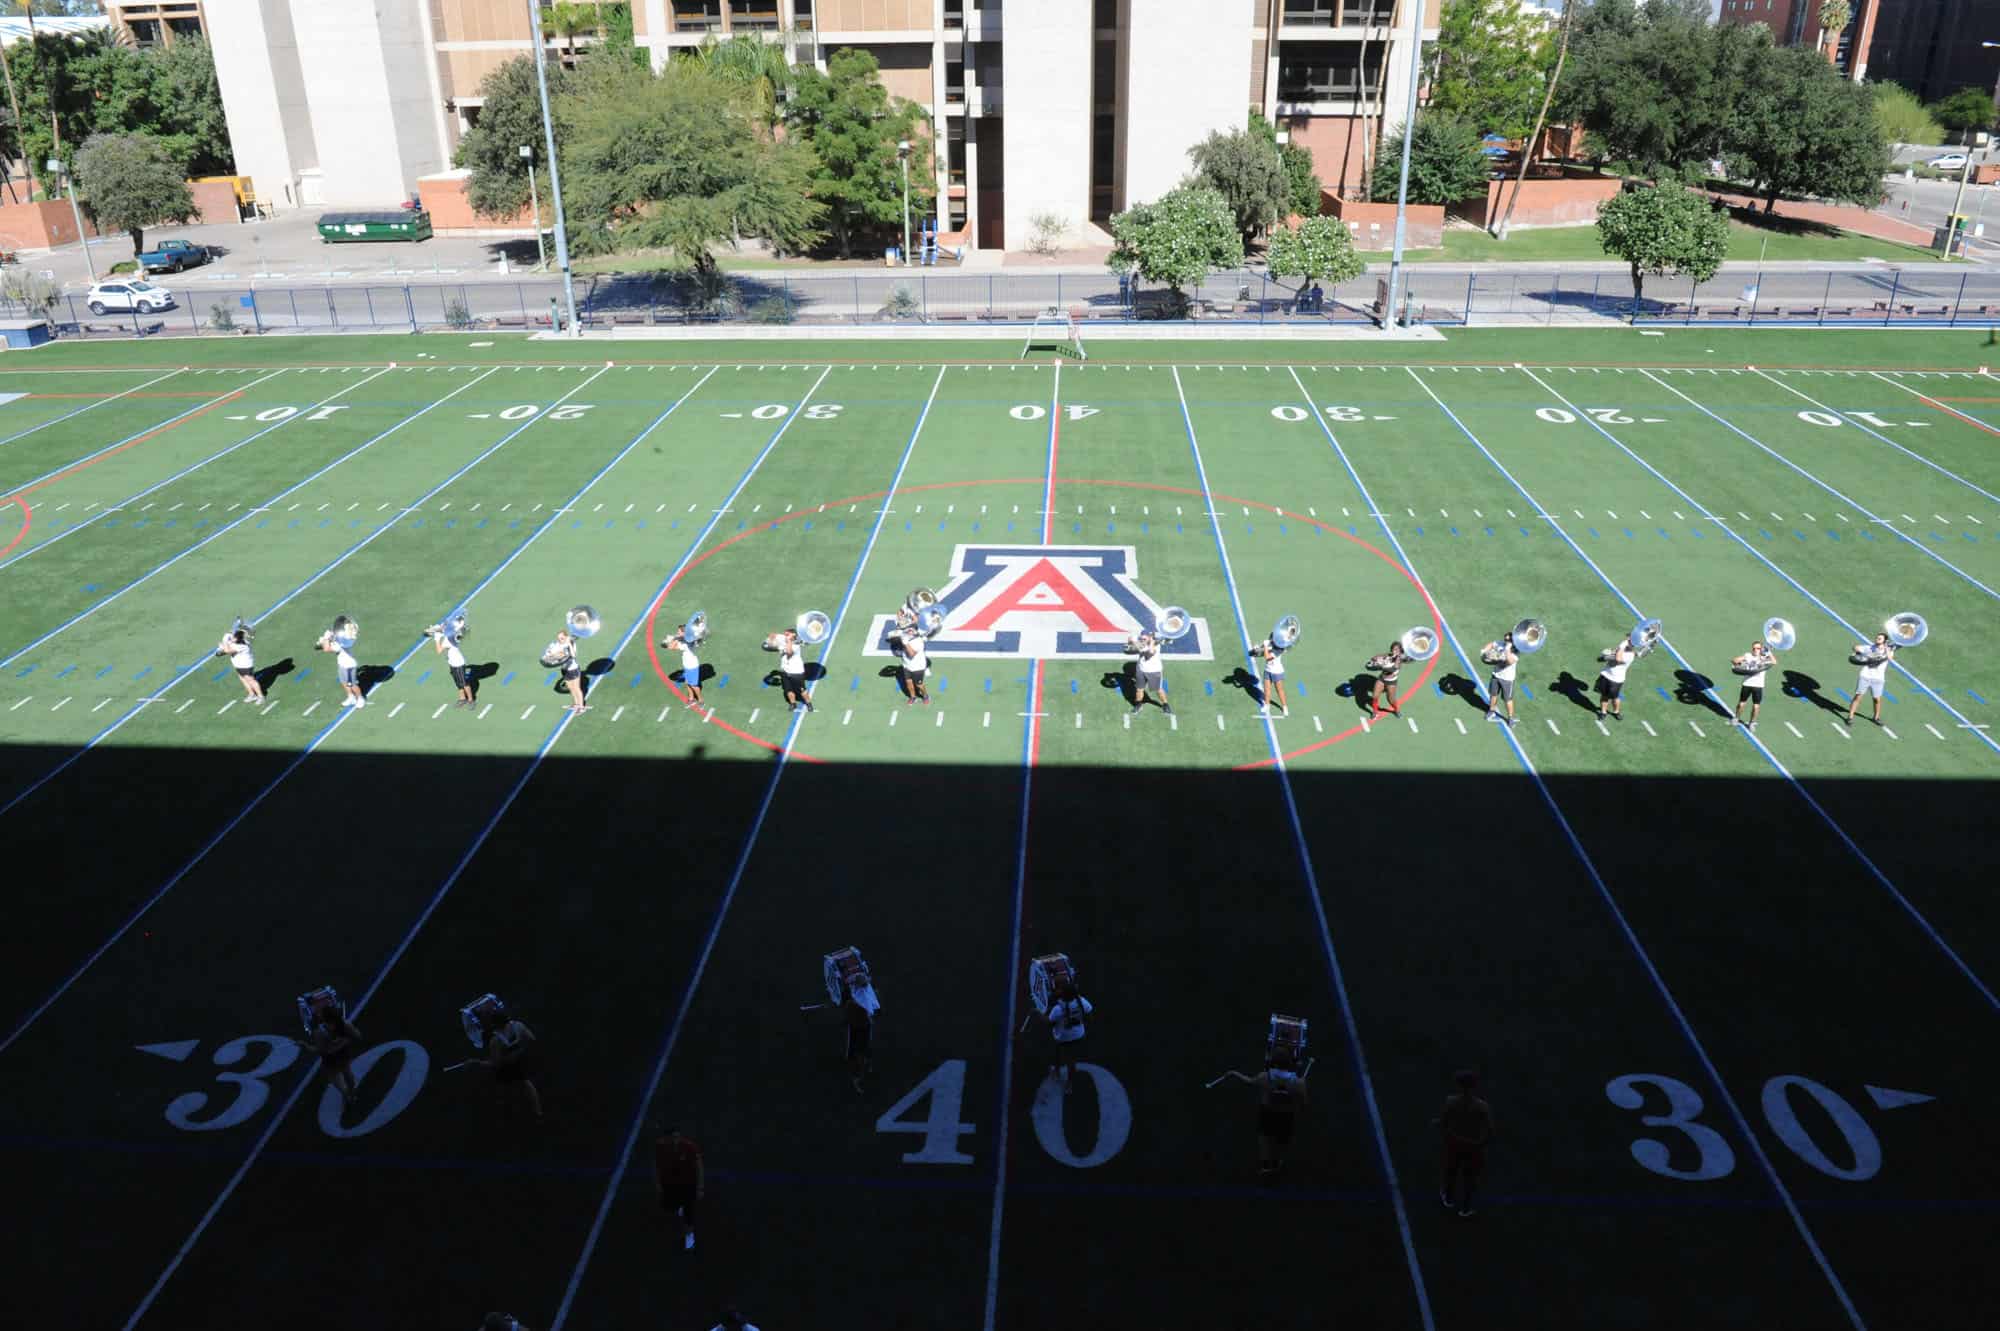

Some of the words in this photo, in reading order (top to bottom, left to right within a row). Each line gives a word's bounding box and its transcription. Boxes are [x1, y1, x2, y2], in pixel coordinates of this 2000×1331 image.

[862, 544, 1213, 660] A
[164, 1034, 431, 1139] 30
[874, 1058, 1134, 1169] 40
[1604, 1073, 1883, 1182] 30
